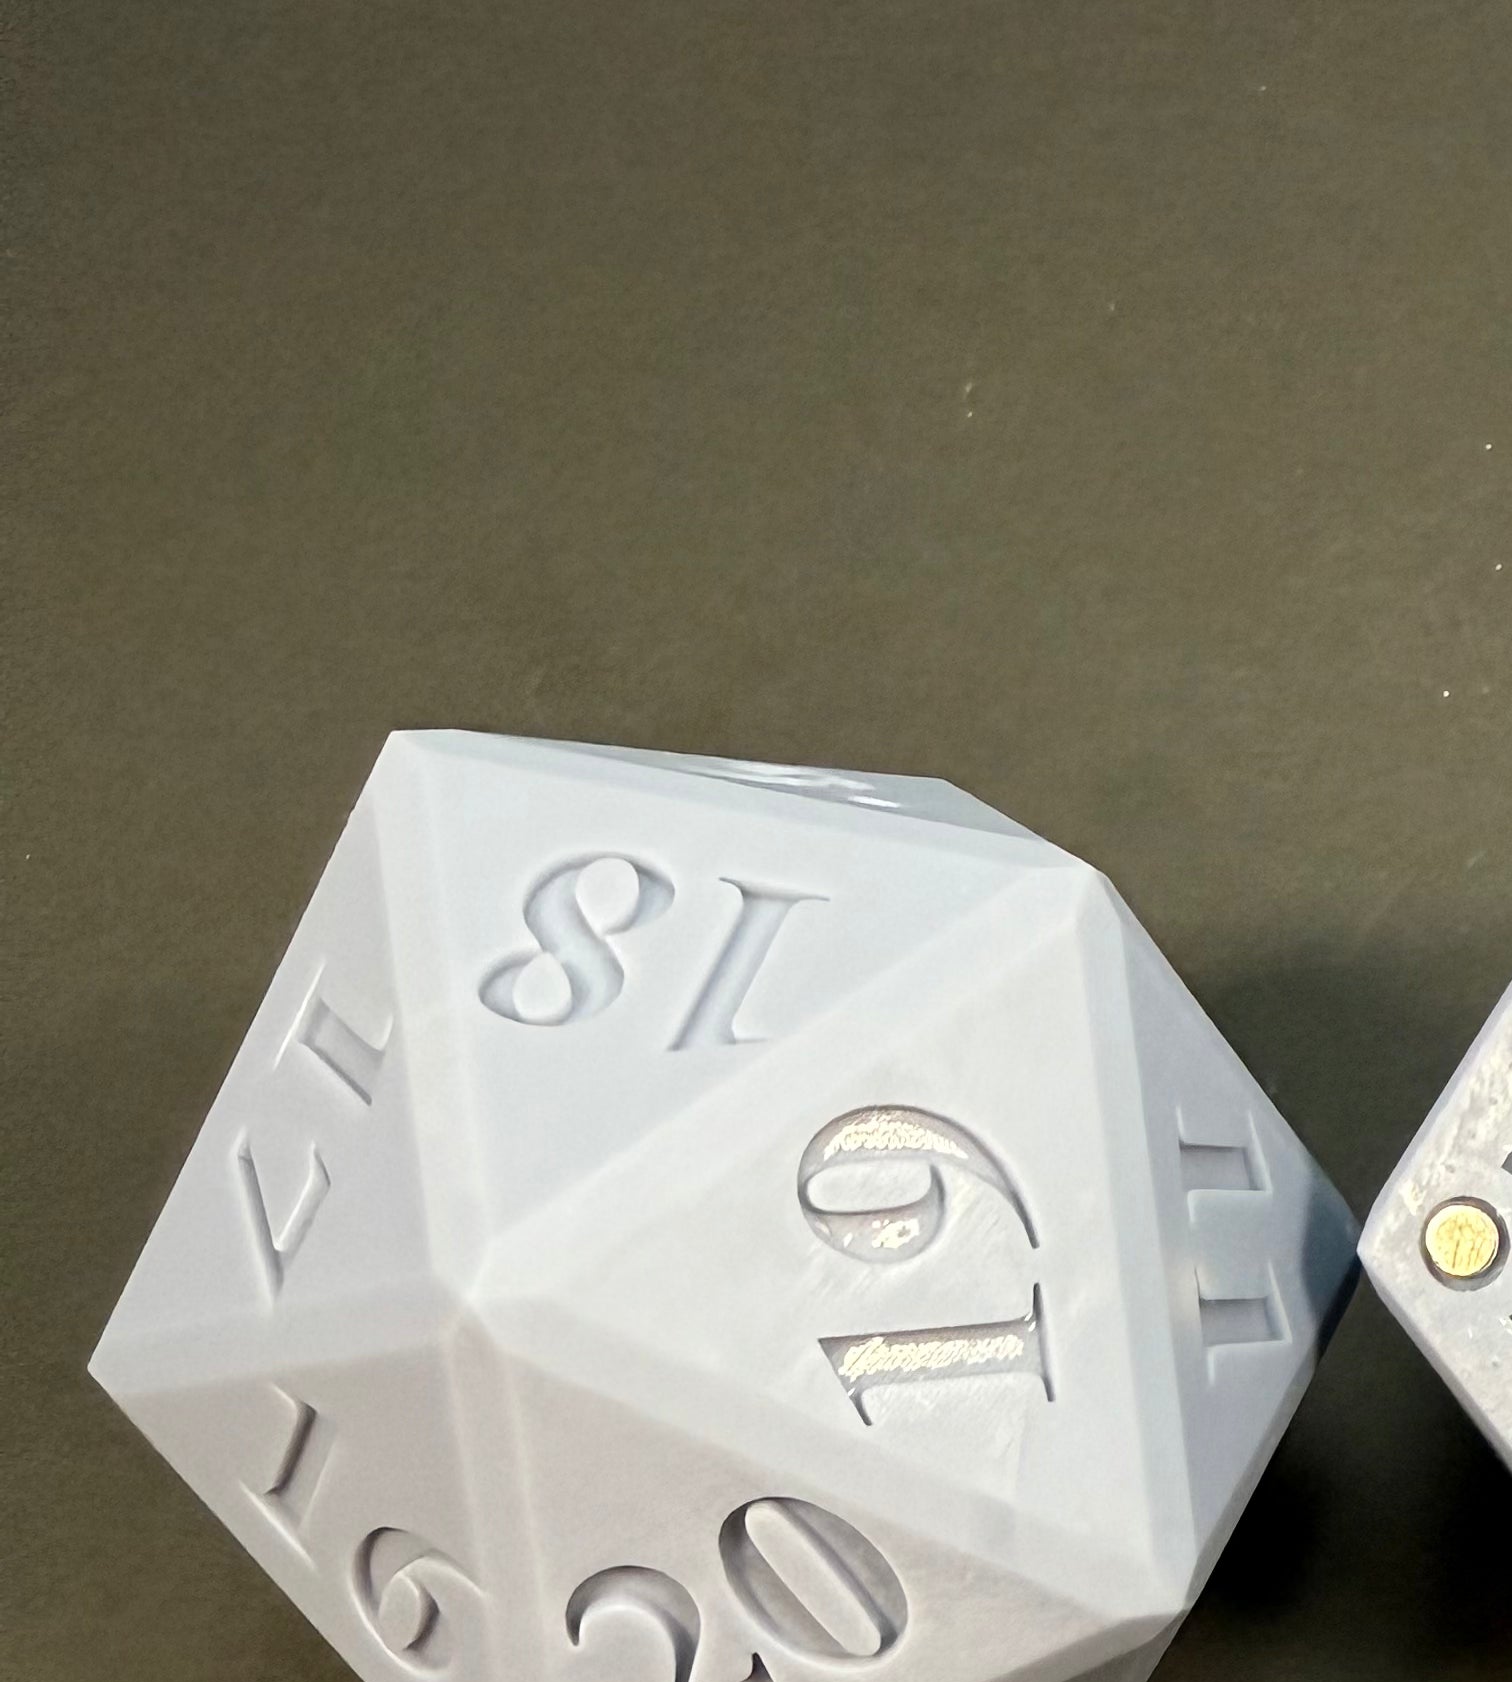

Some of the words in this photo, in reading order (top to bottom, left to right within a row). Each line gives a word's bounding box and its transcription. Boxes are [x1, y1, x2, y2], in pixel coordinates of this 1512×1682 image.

[476, 849, 830, 1053] 18
[229, 960, 394, 1308] 17
[797, 1103, 1057, 1426] 19
[238, 1382, 489, 1681] 16
